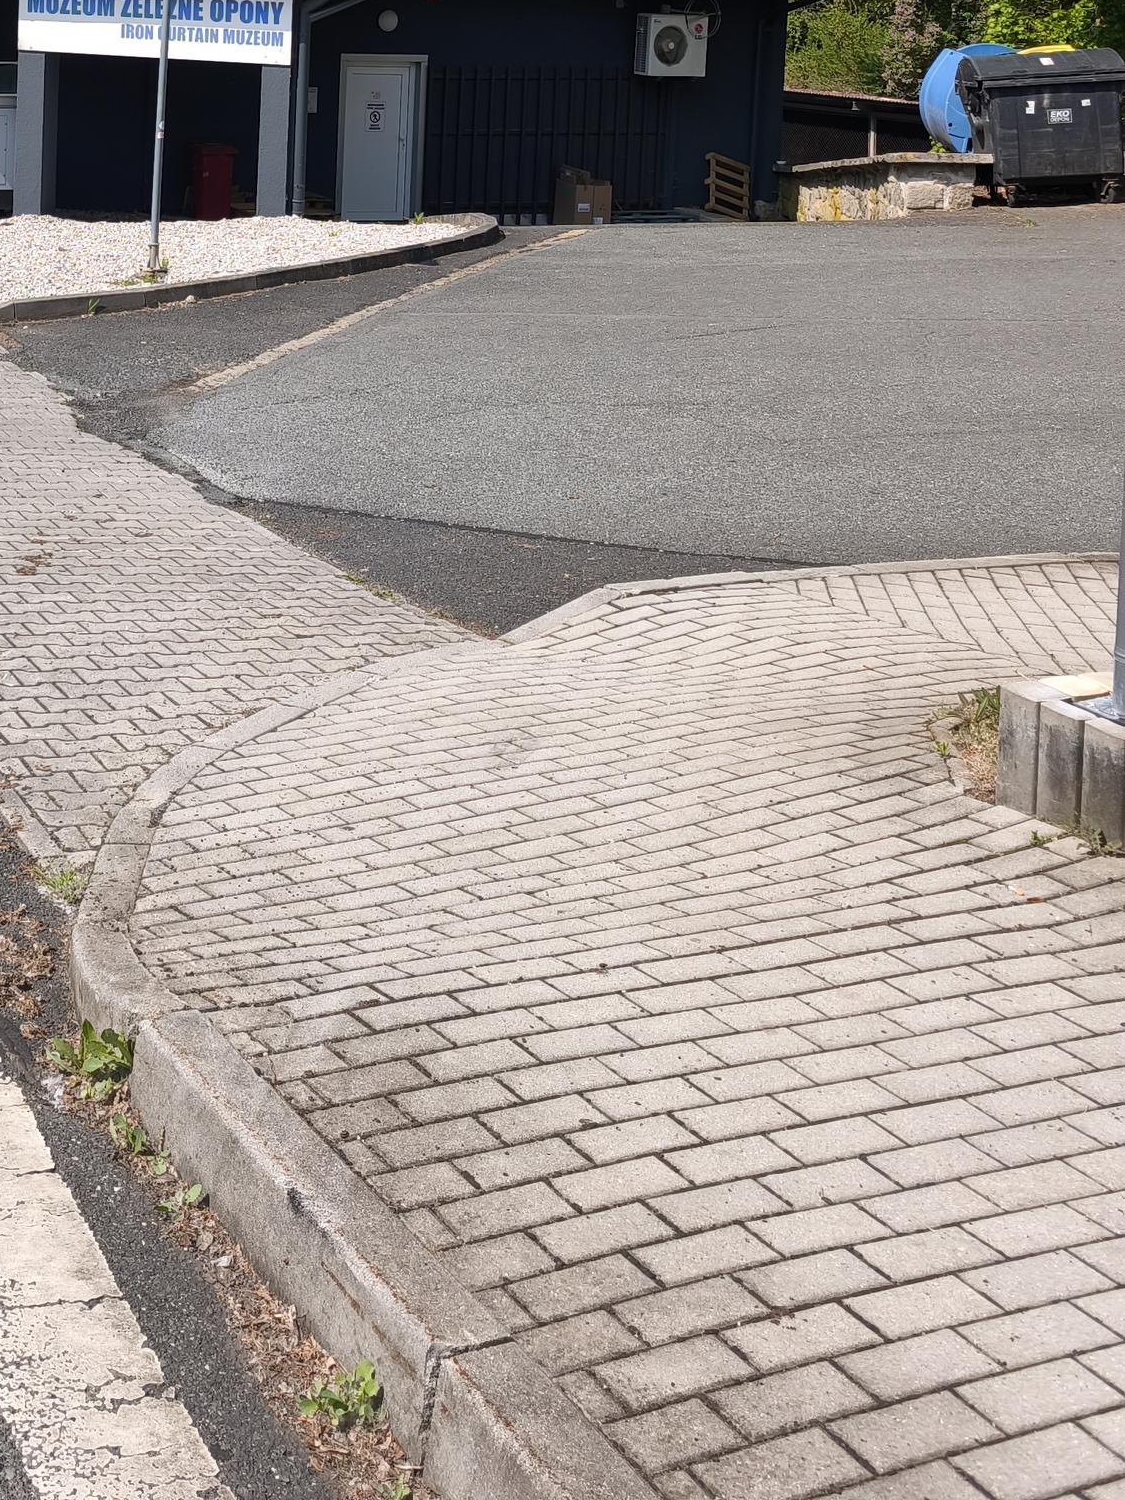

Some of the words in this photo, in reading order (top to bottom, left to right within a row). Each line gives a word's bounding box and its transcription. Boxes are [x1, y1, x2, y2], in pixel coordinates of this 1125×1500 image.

[121, 23, 154, 41] IRON
[222, 30, 285, 48] MUZEUM
[1050, 110, 1070, 118] EKO
